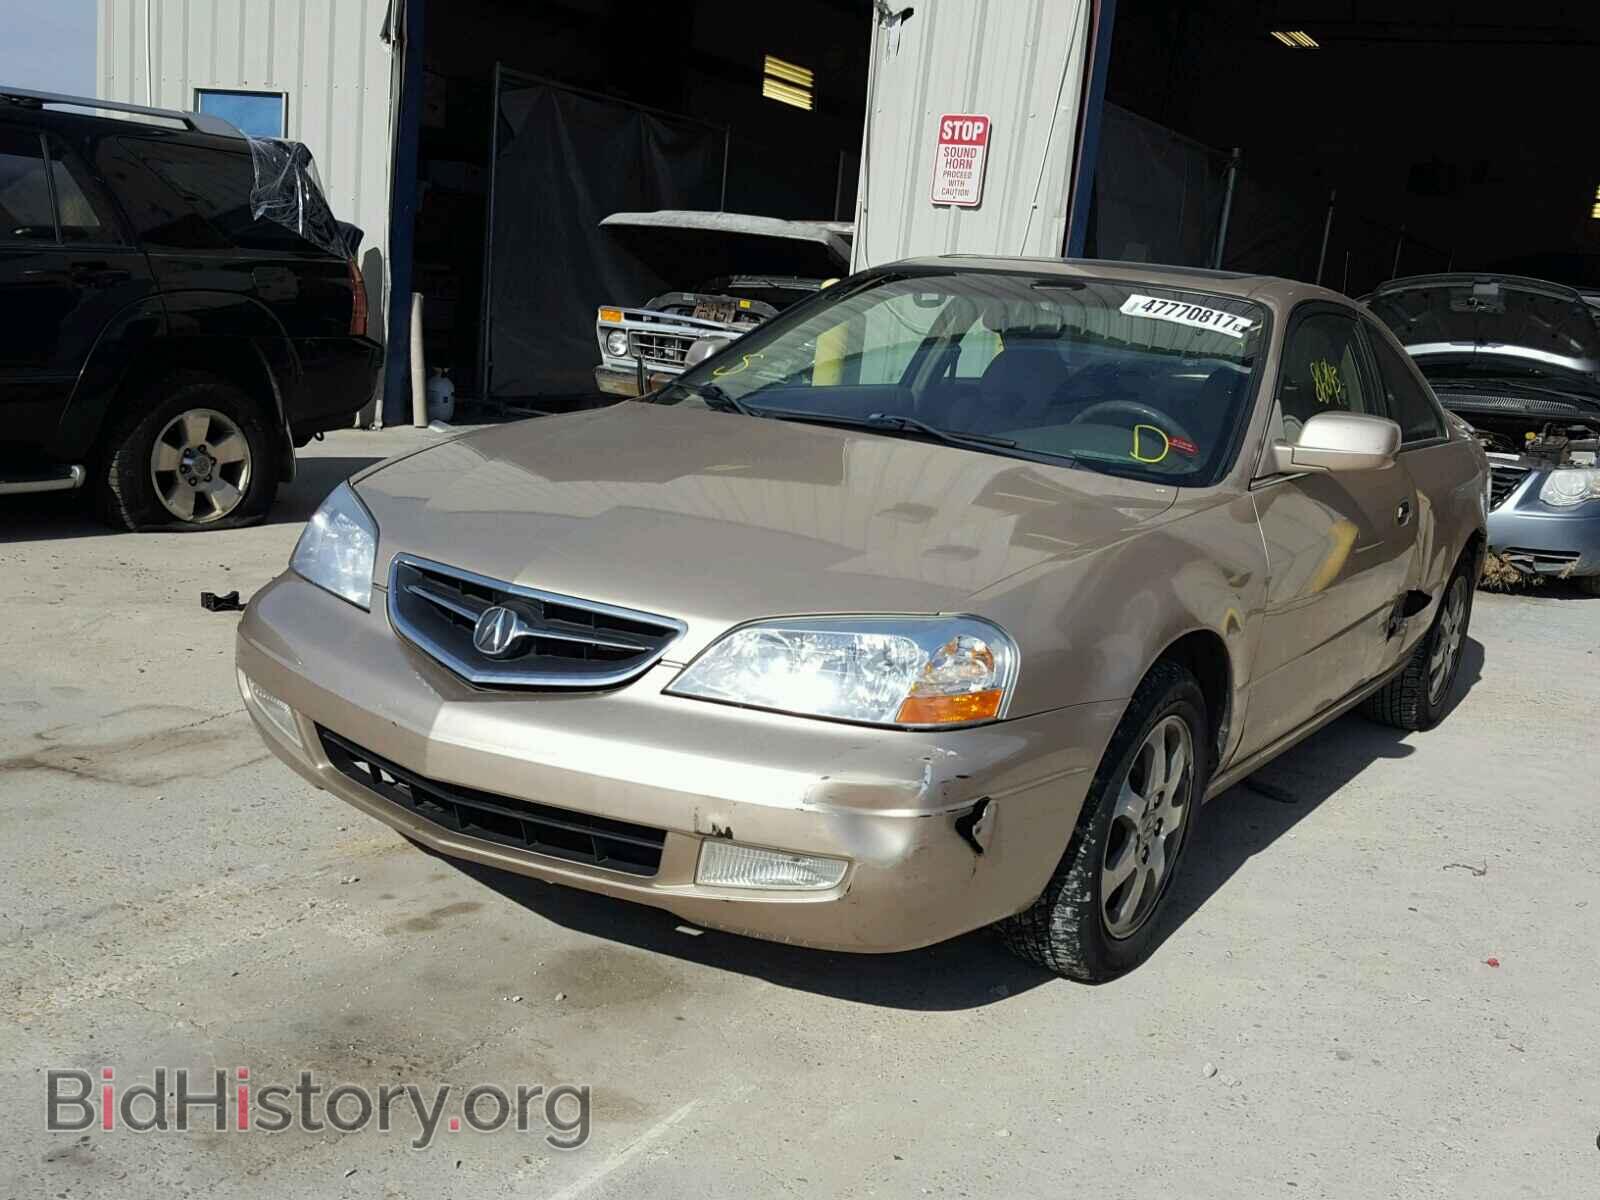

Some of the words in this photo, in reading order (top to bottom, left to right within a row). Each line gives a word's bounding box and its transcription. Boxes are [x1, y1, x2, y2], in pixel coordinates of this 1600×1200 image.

[941, 120, 985, 141] STOP
[943, 147, 977, 158] SOUND
[945, 159, 973, 169] HORN
[942, 170, 973, 179] PROCEED
[948, 179, 965, 187] WITH
[941, 188, 970, 196] CAUTION
[1141, 299, 1238, 328] 47770817
[1129, 424, 1169, 463] D
